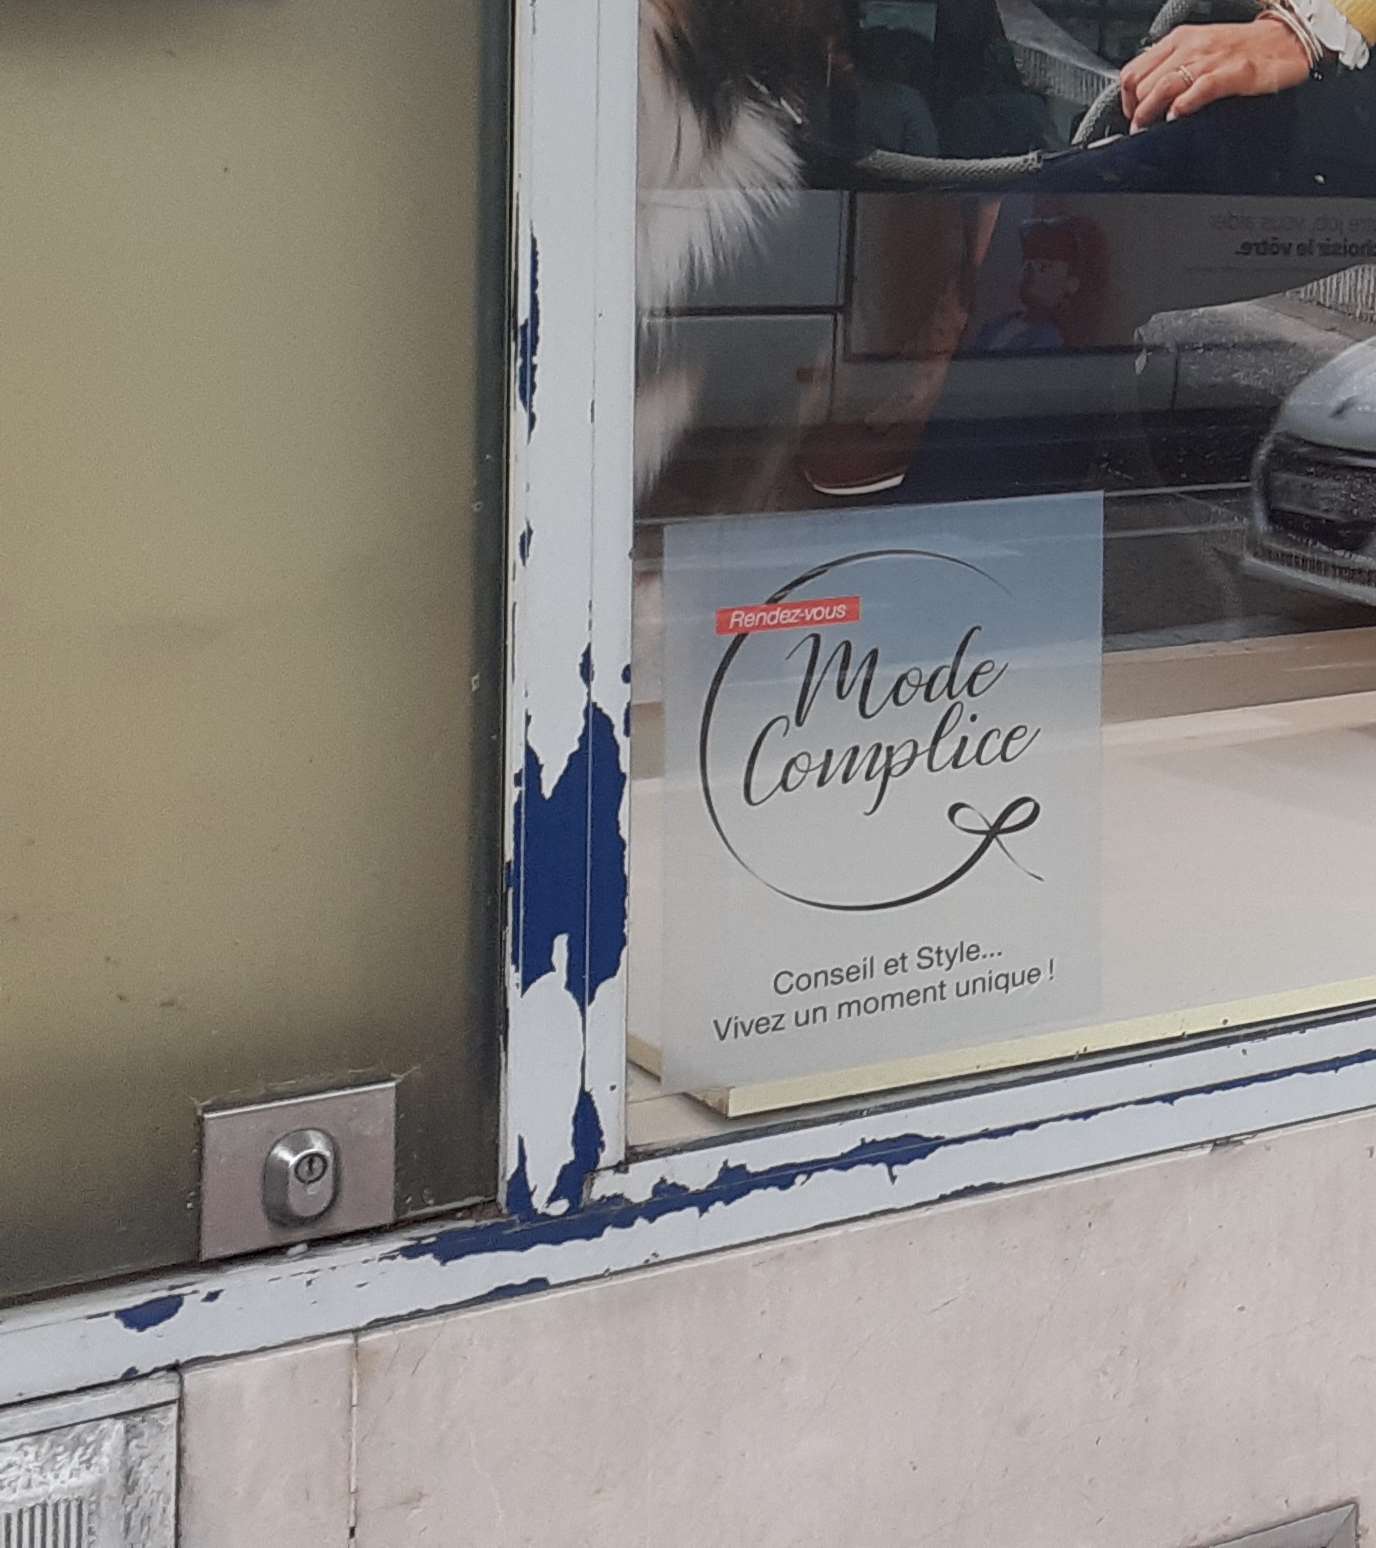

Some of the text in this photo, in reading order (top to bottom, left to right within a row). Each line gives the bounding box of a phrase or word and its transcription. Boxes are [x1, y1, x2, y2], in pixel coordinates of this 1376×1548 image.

[729, 602, 847, 630] Rendez-vous
[785, 625, 1009, 727] Mode
[743, 701, 1041, 816] Complice
[712, 958, 1055, 1042] Vivez un moment unique !
[772, 941, 1003, 995] Conseil et Style...
